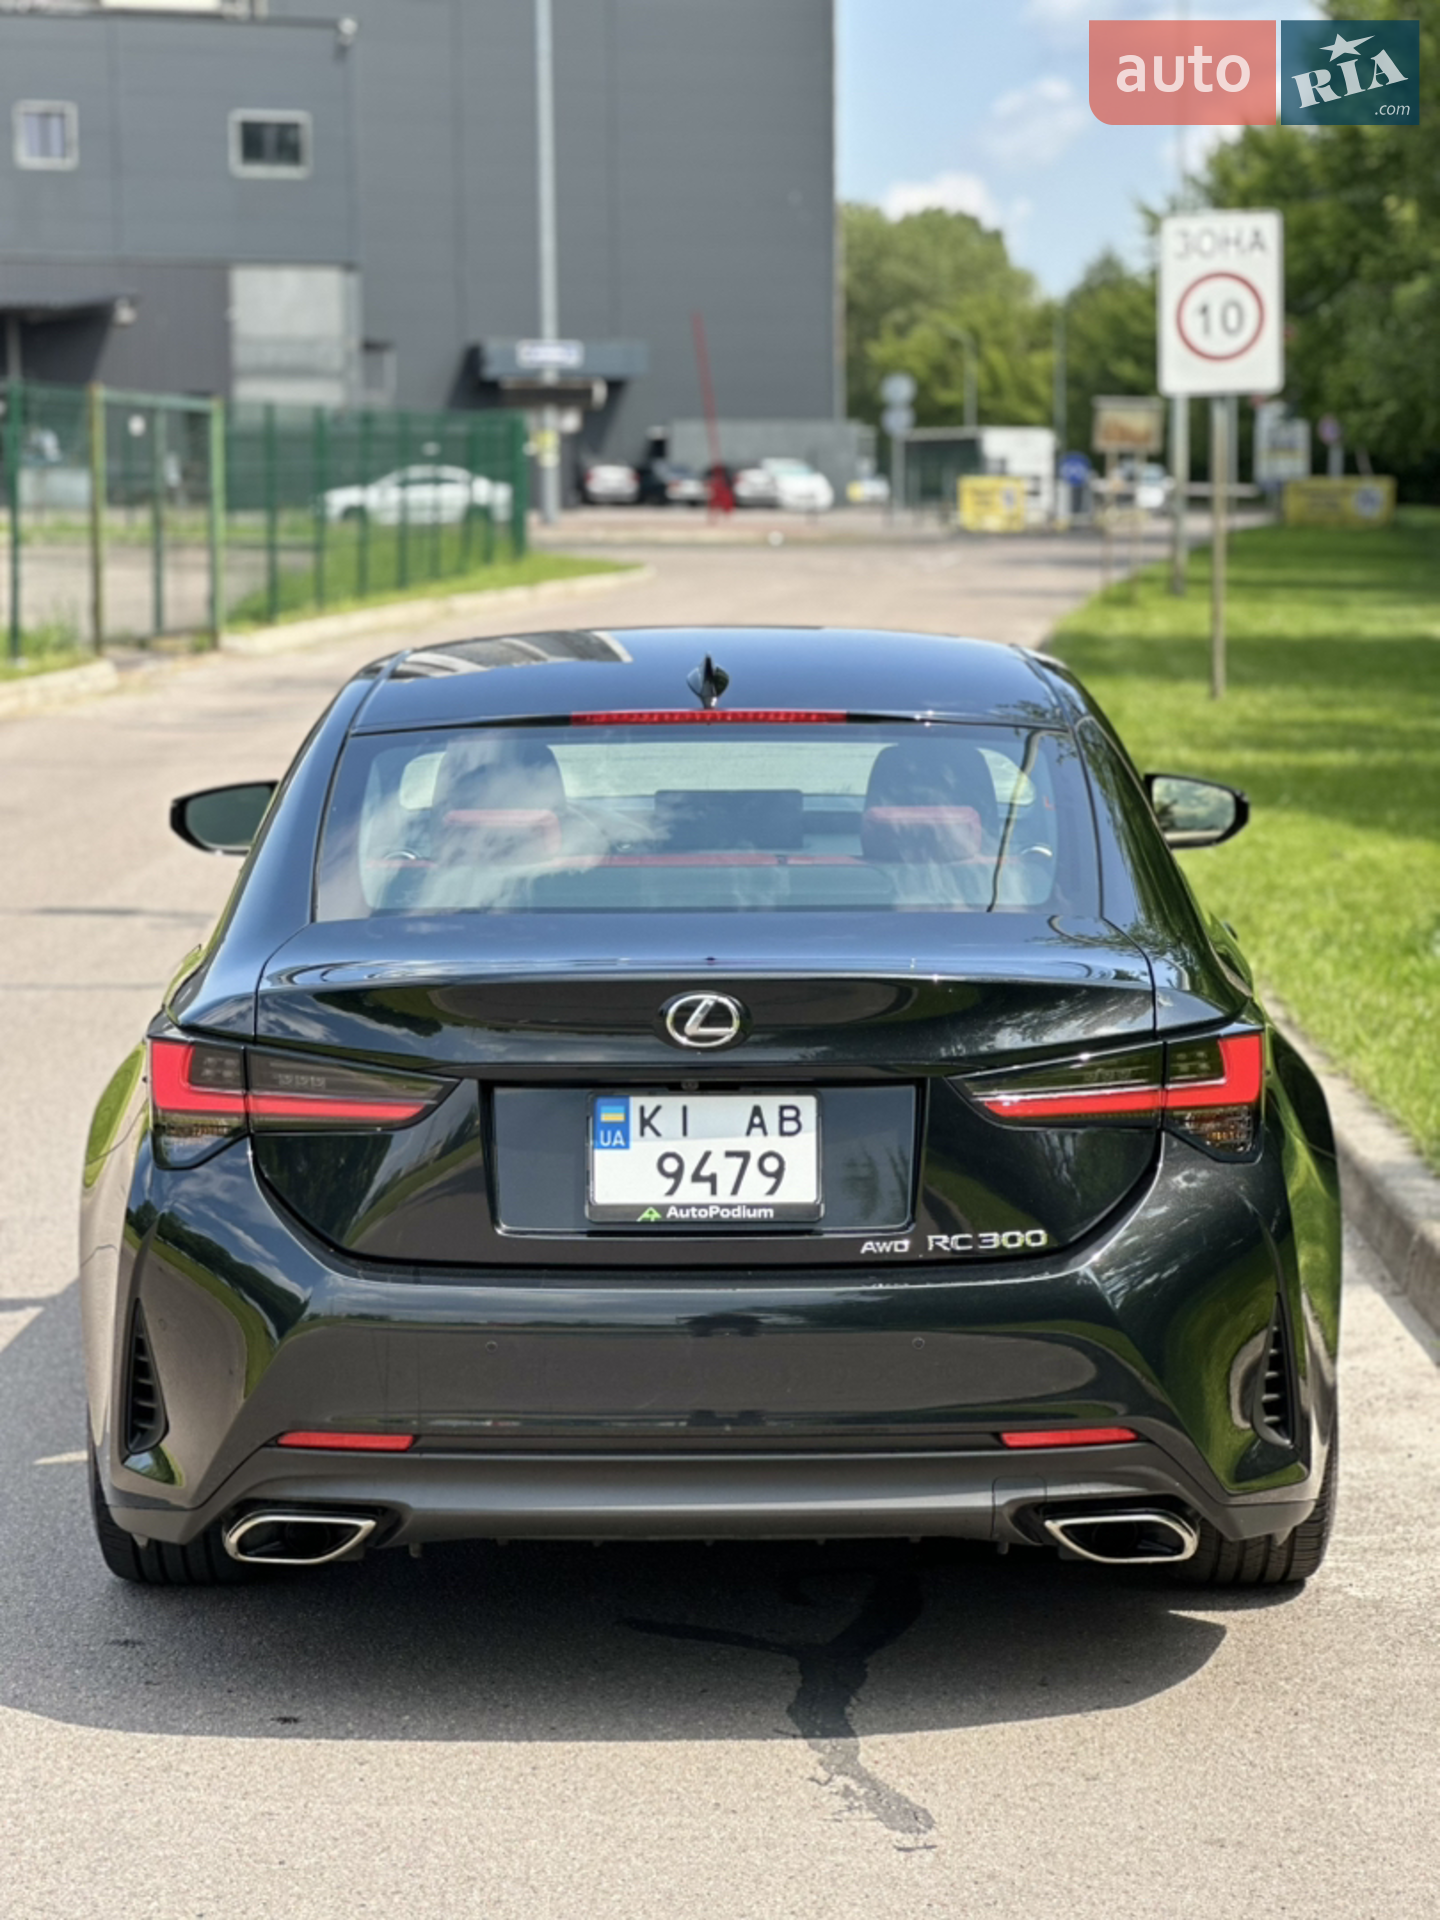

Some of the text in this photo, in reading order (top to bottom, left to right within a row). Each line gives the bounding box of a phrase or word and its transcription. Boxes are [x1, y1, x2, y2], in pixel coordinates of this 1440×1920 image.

[1174, 228, 1269, 260] ЗОНА
[1197, 299, 1245, 338] 10
[638, 1104, 803, 1138] KI AB
[599, 1130, 625, 1147] UA
[656, 1150, 786, 1197] 9479
[666, 1204, 775, 1220] AutoPodium
[860, 1239, 911, 1254] AWD
